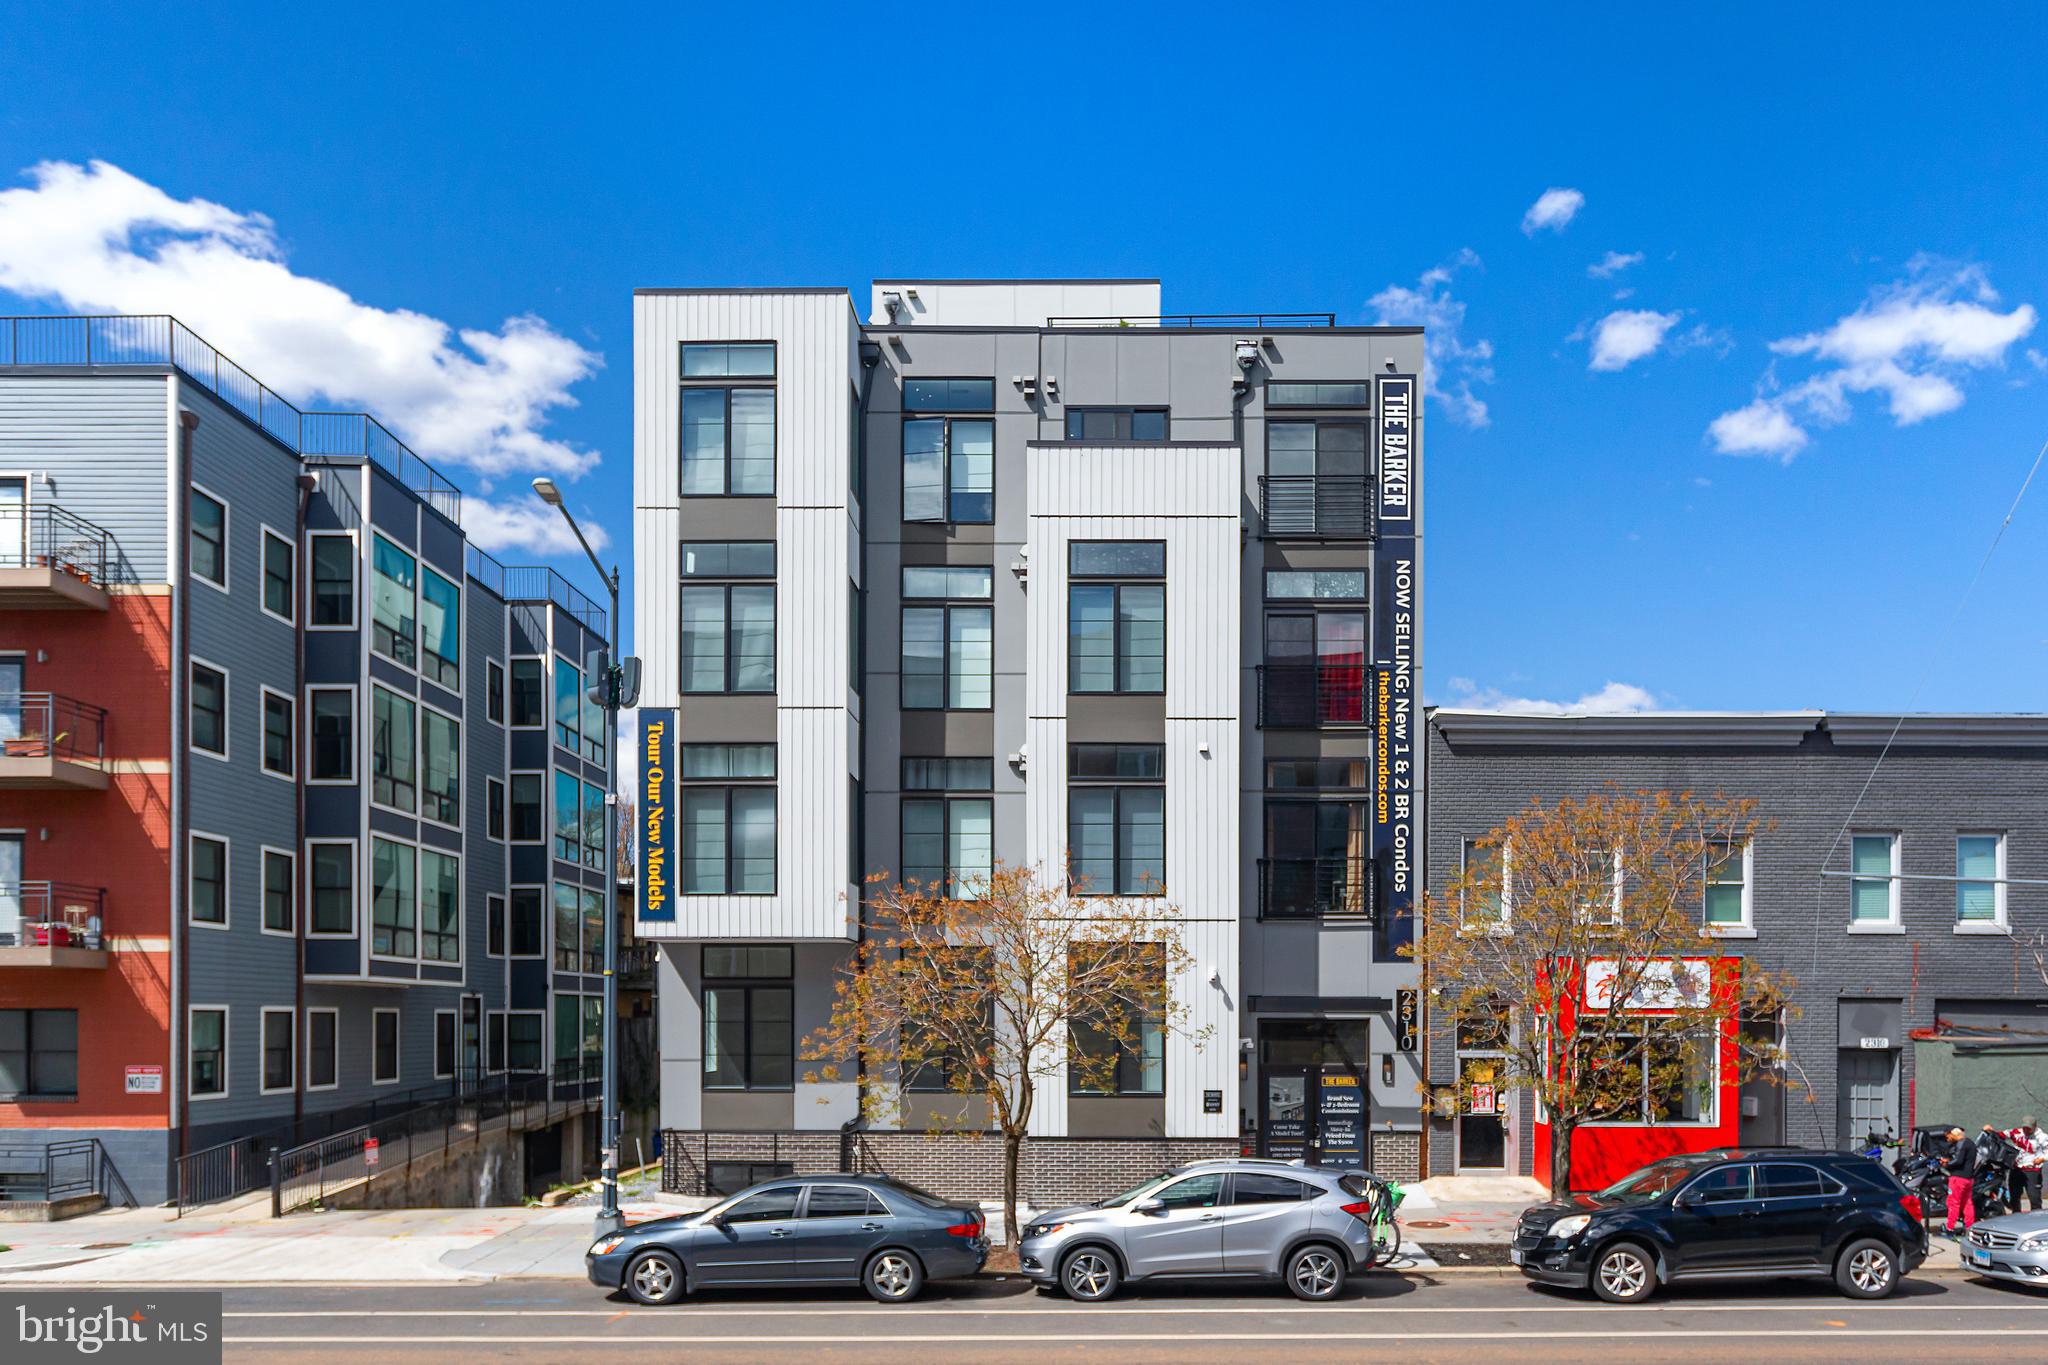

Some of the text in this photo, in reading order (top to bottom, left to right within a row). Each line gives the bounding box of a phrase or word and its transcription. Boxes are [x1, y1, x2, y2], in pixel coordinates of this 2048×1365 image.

[1383, 392, 1408, 506] THE BARKER
[1377, 671, 1391, 824] thebarkercondos.com
[1394, 559, 1411, 893] NOW SELLING: New 1 & 2 BR Condos
[647, 720, 666, 911] Tour Our New Models
[128, 1076, 141, 1089] NO
